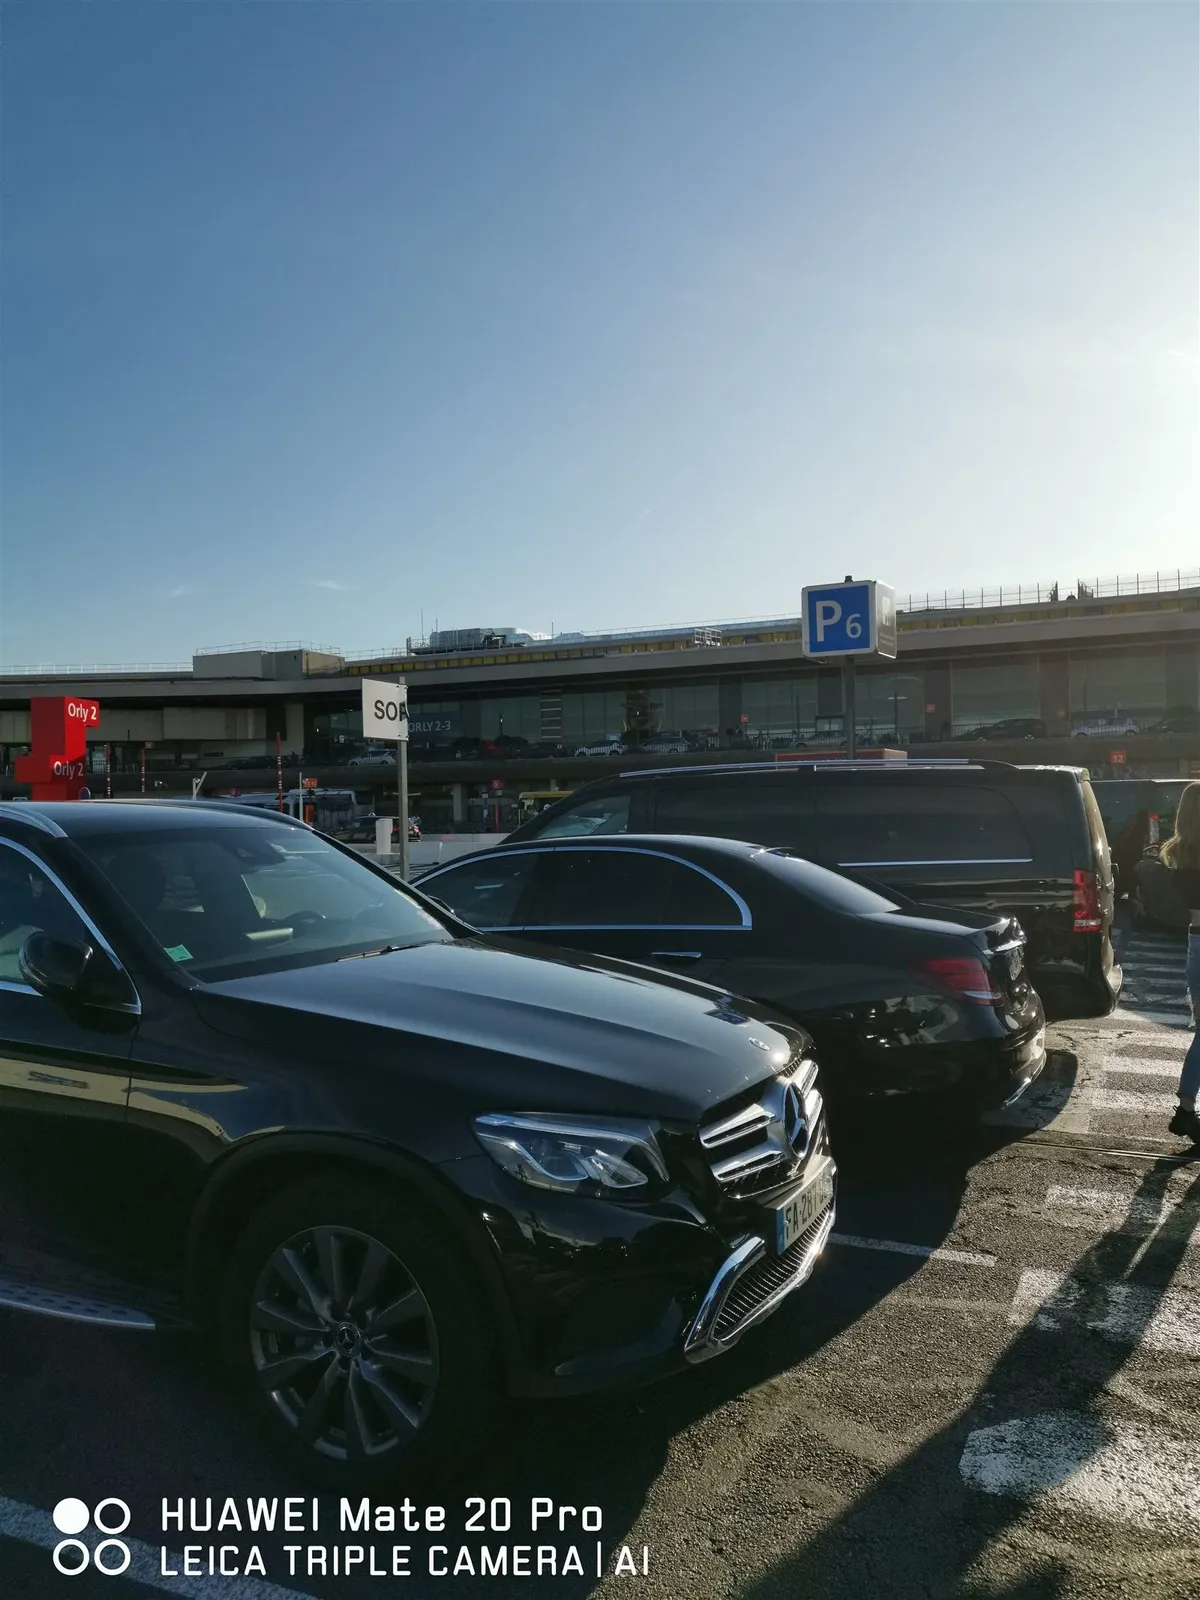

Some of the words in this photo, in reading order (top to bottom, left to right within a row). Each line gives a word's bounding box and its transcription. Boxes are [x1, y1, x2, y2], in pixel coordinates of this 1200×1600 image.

[815, 600, 842, 643] P
[845, 613, 862, 639] 6
[68, 702, 89, 722] Orly
[91, 706, 97, 720] 2
[408, 721, 434, 733] ORLY
[435, 720, 451, 731] 2-3
[1112, 754, 1125, 763] 12
[53, 760, 75, 780] Orly
[78, 762, 84, 777] 2
